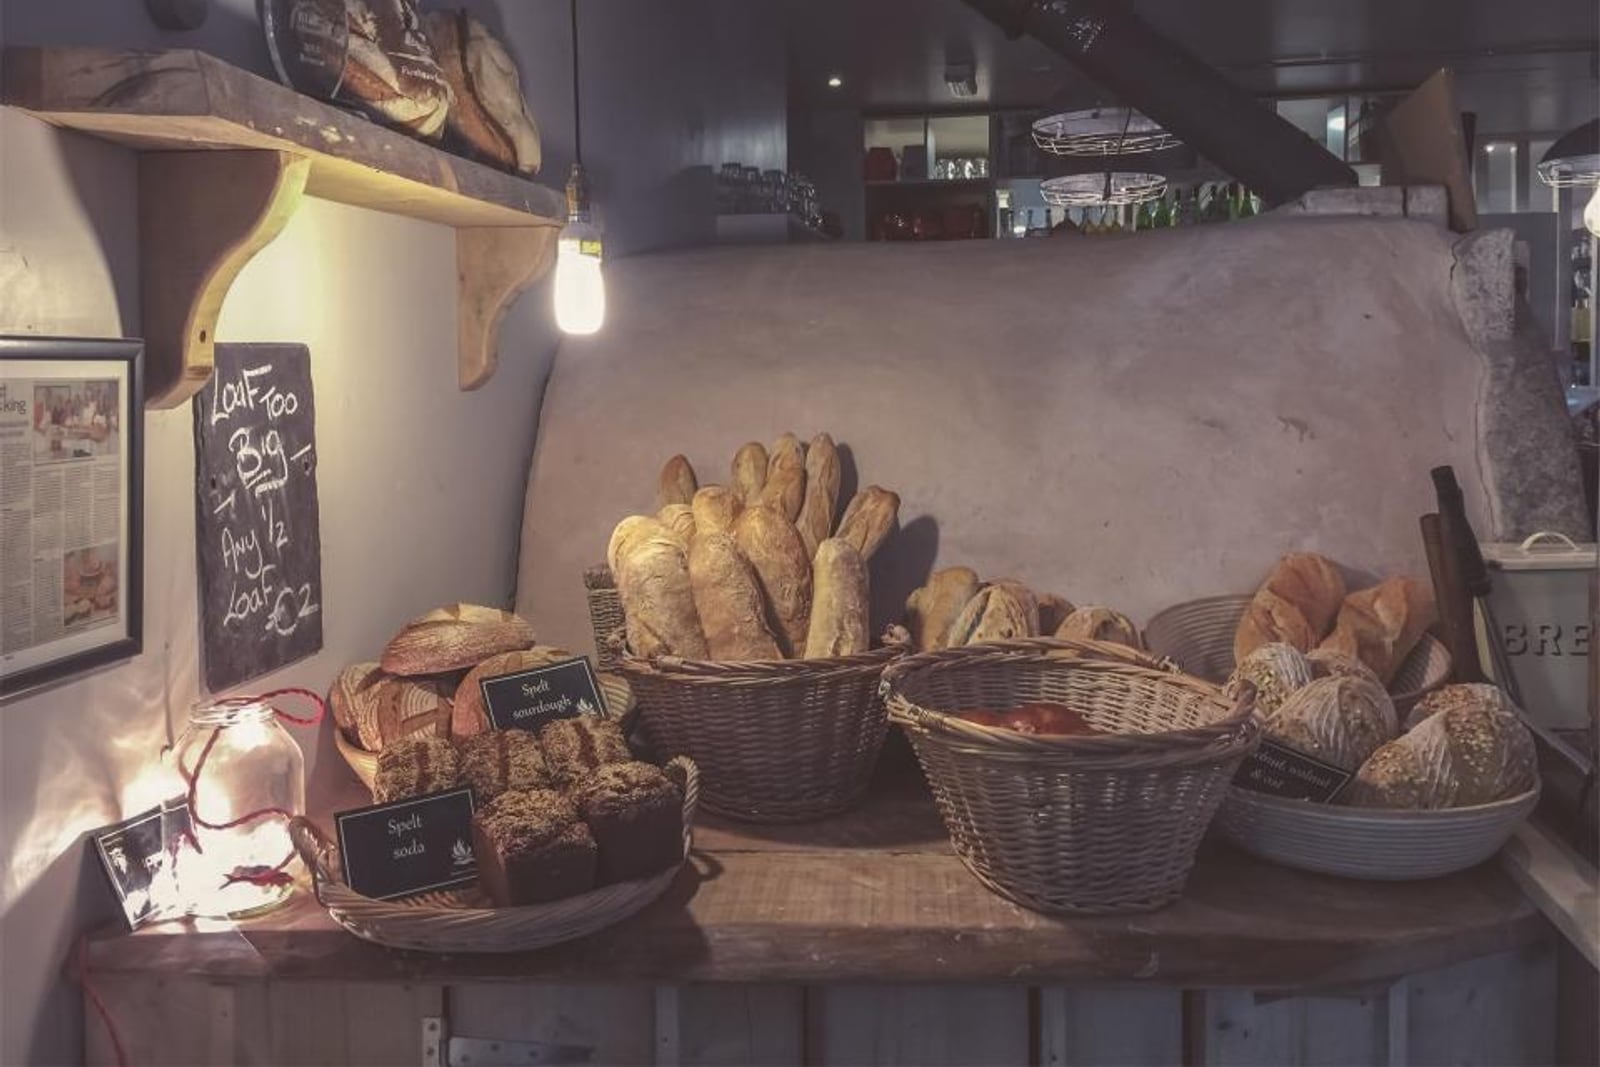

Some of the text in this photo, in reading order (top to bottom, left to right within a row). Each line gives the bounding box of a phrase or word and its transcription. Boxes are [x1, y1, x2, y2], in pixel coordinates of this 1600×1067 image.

[1503, 624, 1588, 657] BRE
[521, 679, 550, 698] Spelt
[512, 694, 572, 719] sourdough
[387, 812, 423, 838] Spelt
[393, 838, 425, 860] soda
